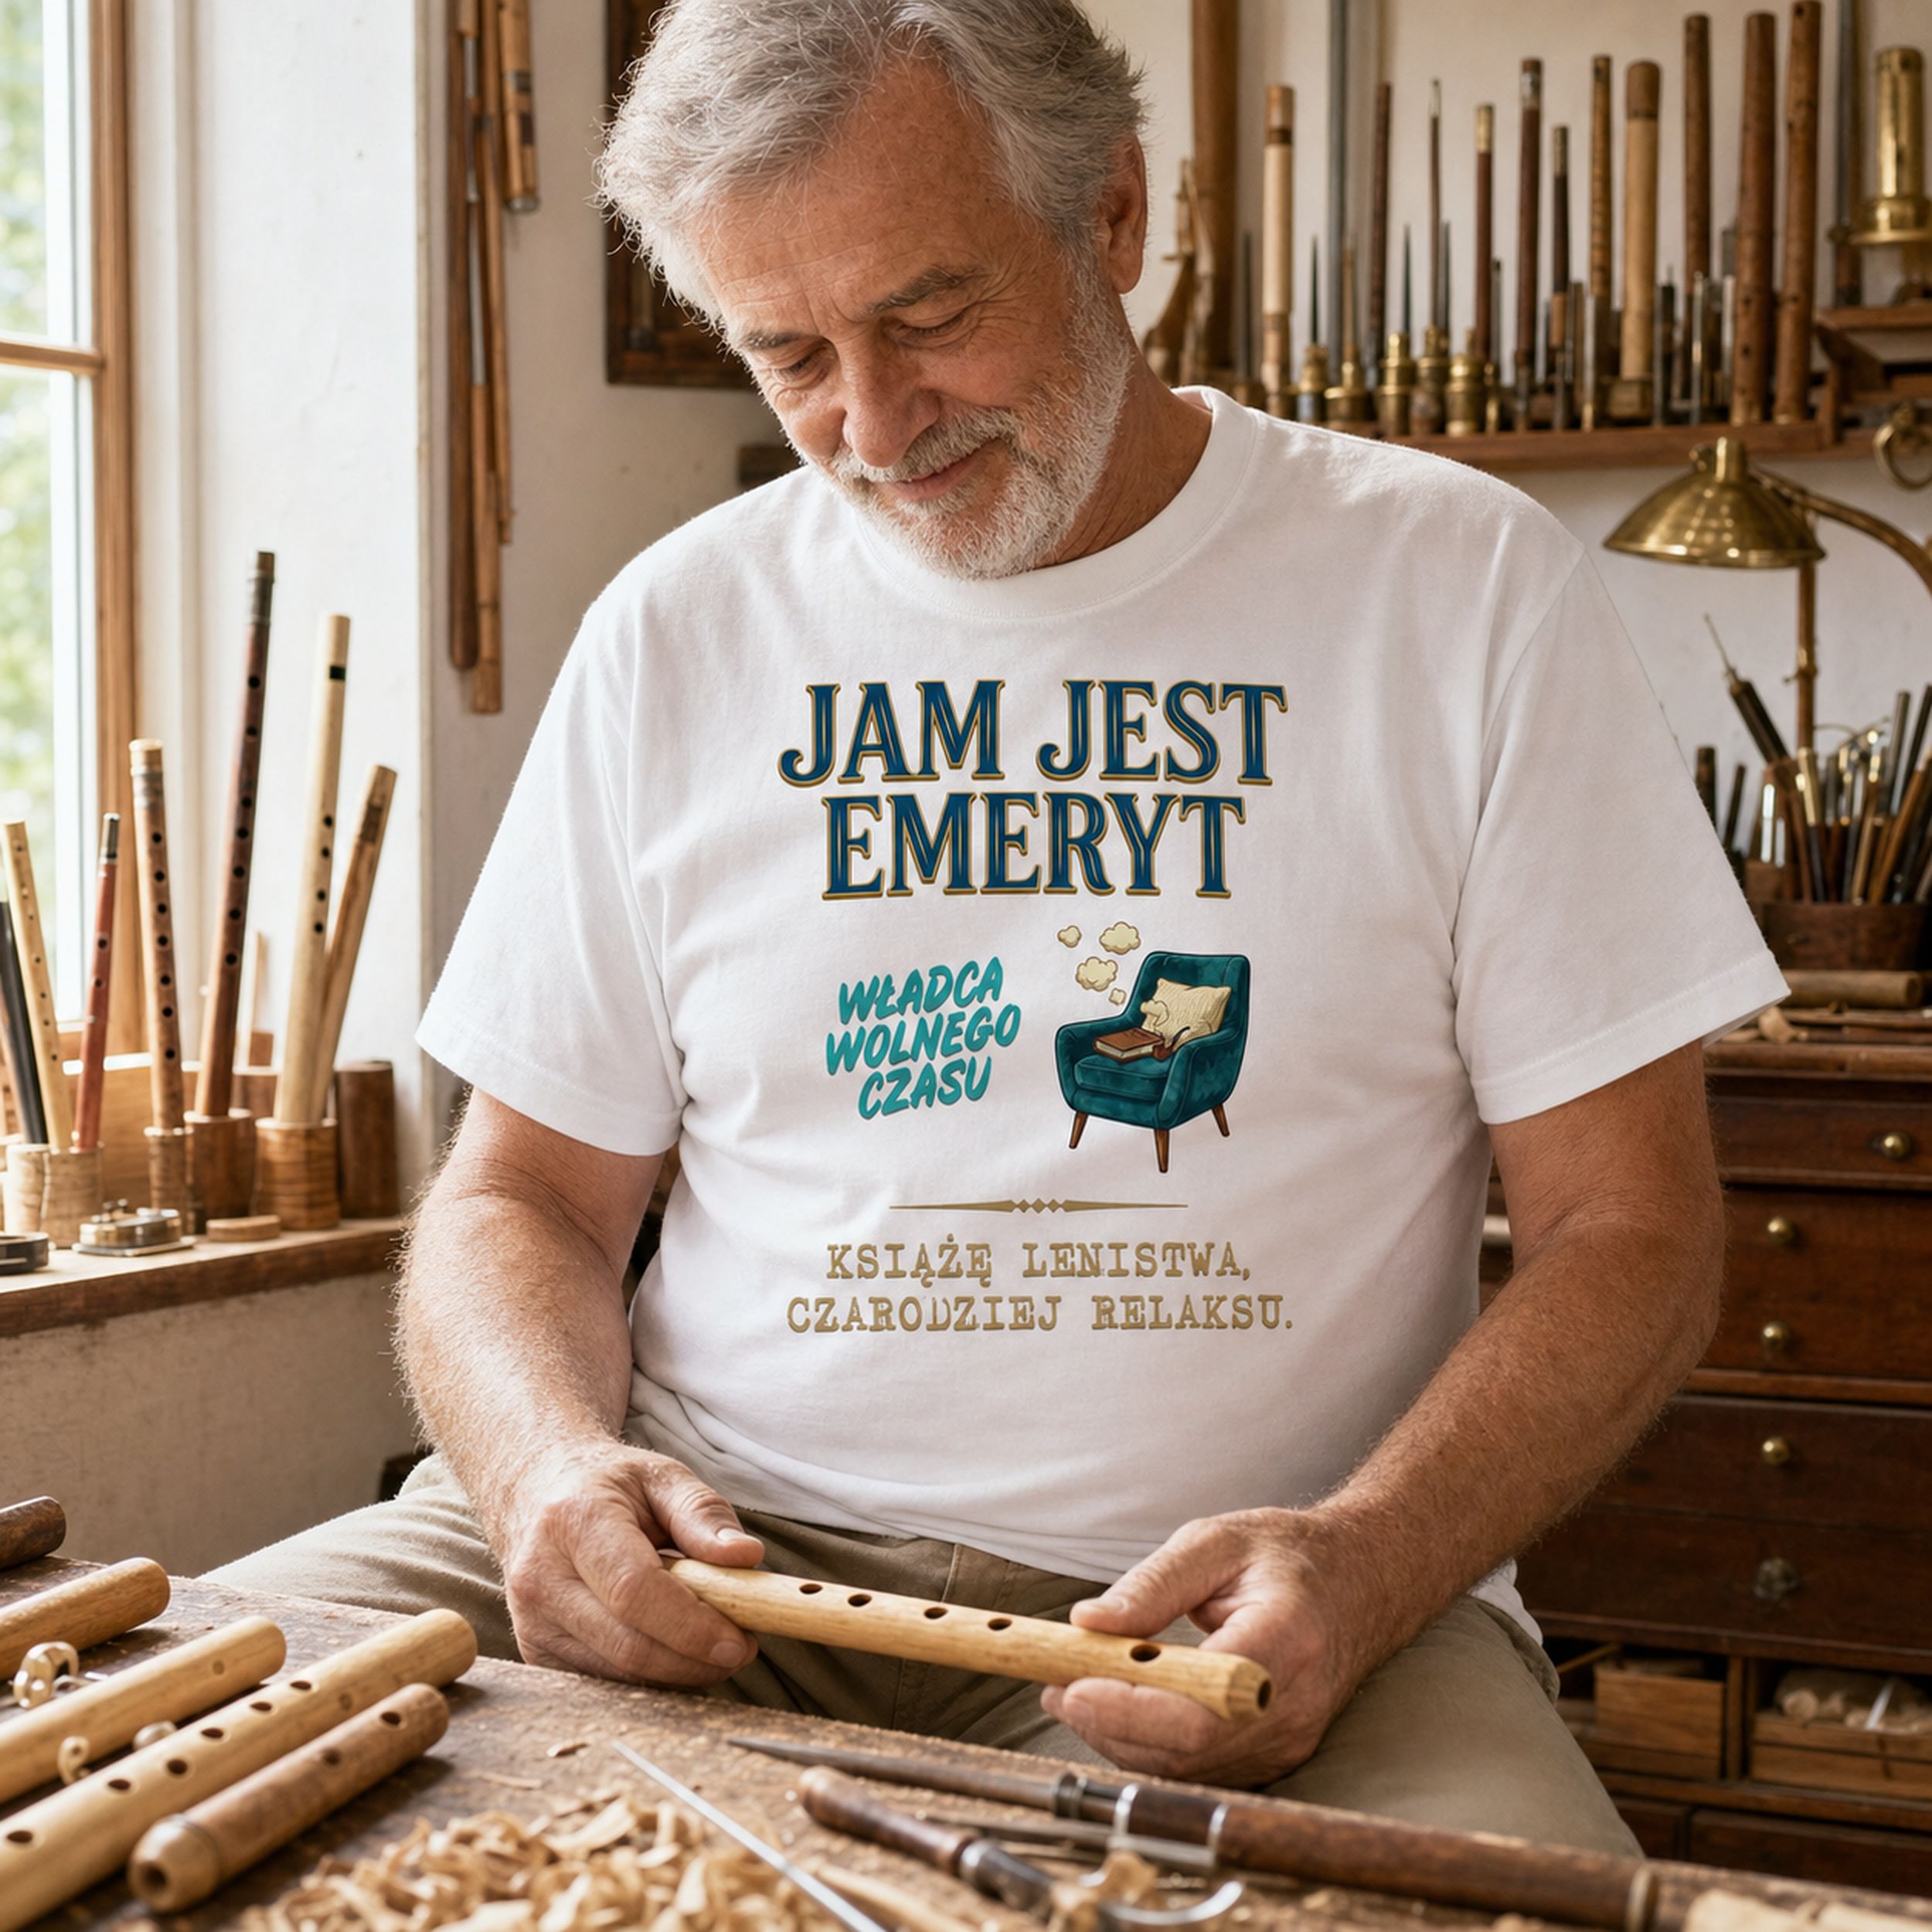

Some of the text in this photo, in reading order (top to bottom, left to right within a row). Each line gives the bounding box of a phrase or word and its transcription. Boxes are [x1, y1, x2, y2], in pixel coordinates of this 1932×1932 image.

[777, 679, 1288, 787] JAM JEST
[821, 791, 1246, 900] EMERYT
[838, 956, 1003, 1025] WŁADCA
[826, 1003, 1021, 1076] WOLNEGO
[858, 1056, 992, 1120] CZASU
[826, 1233, 1250, 1288] KSIĄŻĘ LENISTWA,
[786, 1294, 1293, 1333] CZARODZIEJ RELAKSU.
